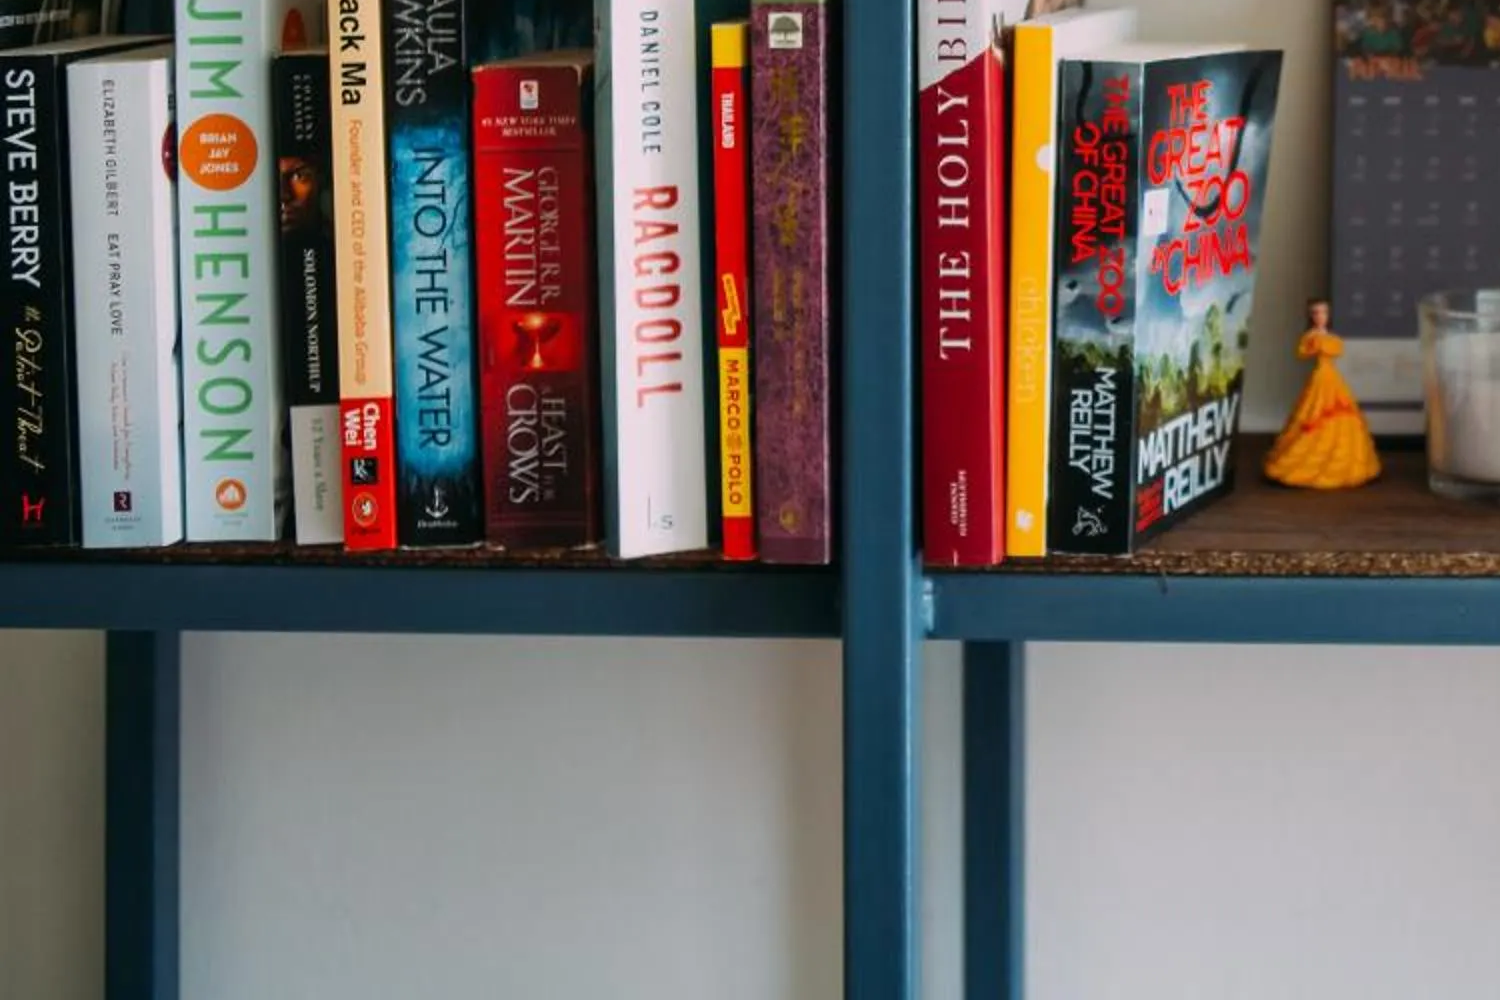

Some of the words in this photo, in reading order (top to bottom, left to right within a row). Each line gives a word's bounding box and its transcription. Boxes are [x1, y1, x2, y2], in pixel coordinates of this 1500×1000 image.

[341, 62, 367, 106] Ma
[639, 11, 661, 92] DANIEL
[5, 68, 38, 171] STEVE
[102, 79, 118, 155] ELIZABETH
[642, 101, 662, 155] COLE
[721, 93, 735, 149] THAILAND
[1102, 72, 1130, 135] THE
[1167, 78, 1213, 124] THE
[199, 132, 238, 144] BRIAN
[199, 162, 240, 174] JONES
[349, 119, 363, 177] Founder
[937, 87, 970, 228] HOLY
[1073, 121, 1100, 167] OF
[1147, 115, 1247, 185] GREAT
[105, 159, 120, 217] GILBERT
[413, 147, 447, 238] INTO
[1071, 171, 1097, 264] CHINA
[1100, 140, 1128, 242] GREAT
[1184, 169, 1250, 233] ZOO
[9, 180, 41, 289] BERRY
[107, 233, 121, 259] EAT
[503, 167, 538, 306] MARTIN
[1162, 222, 1253, 296] CHINA
[108, 263, 122, 298] PRAY
[303, 248, 318, 321] SOLOMON
[353, 260, 367, 284] the
[415, 249, 449, 315] THE
[631, 185, 682, 409] RAGDOLL
[938, 250, 972, 360] THE
[1096, 243, 1125, 317] ZOO
[109, 302, 123, 336] LOVE
[193, 204, 255, 463] HENSON
[354, 286, 368, 338] Alibaba
[305, 324, 321, 393] NORTHUP
[354, 341, 368, 385] Group
[417, 325, 451, 450] WATER
[344, 408, 362, 446] Wei
[362, 402, 381, 450] Chen
[726, 359, 742, 430] MARCO
[507, 383, 540, 504] CROWS
[541, 397, 568, 475] FEAST
[1068, 388, 1093, 474] REILLY
[1091, 366, 1118, 500] MATTHEW
[1137, 391, 1239, 486] MATTHEW
[729, 454, 743, 506] POLO
[1163, 440, 1232, 515] REILLY
